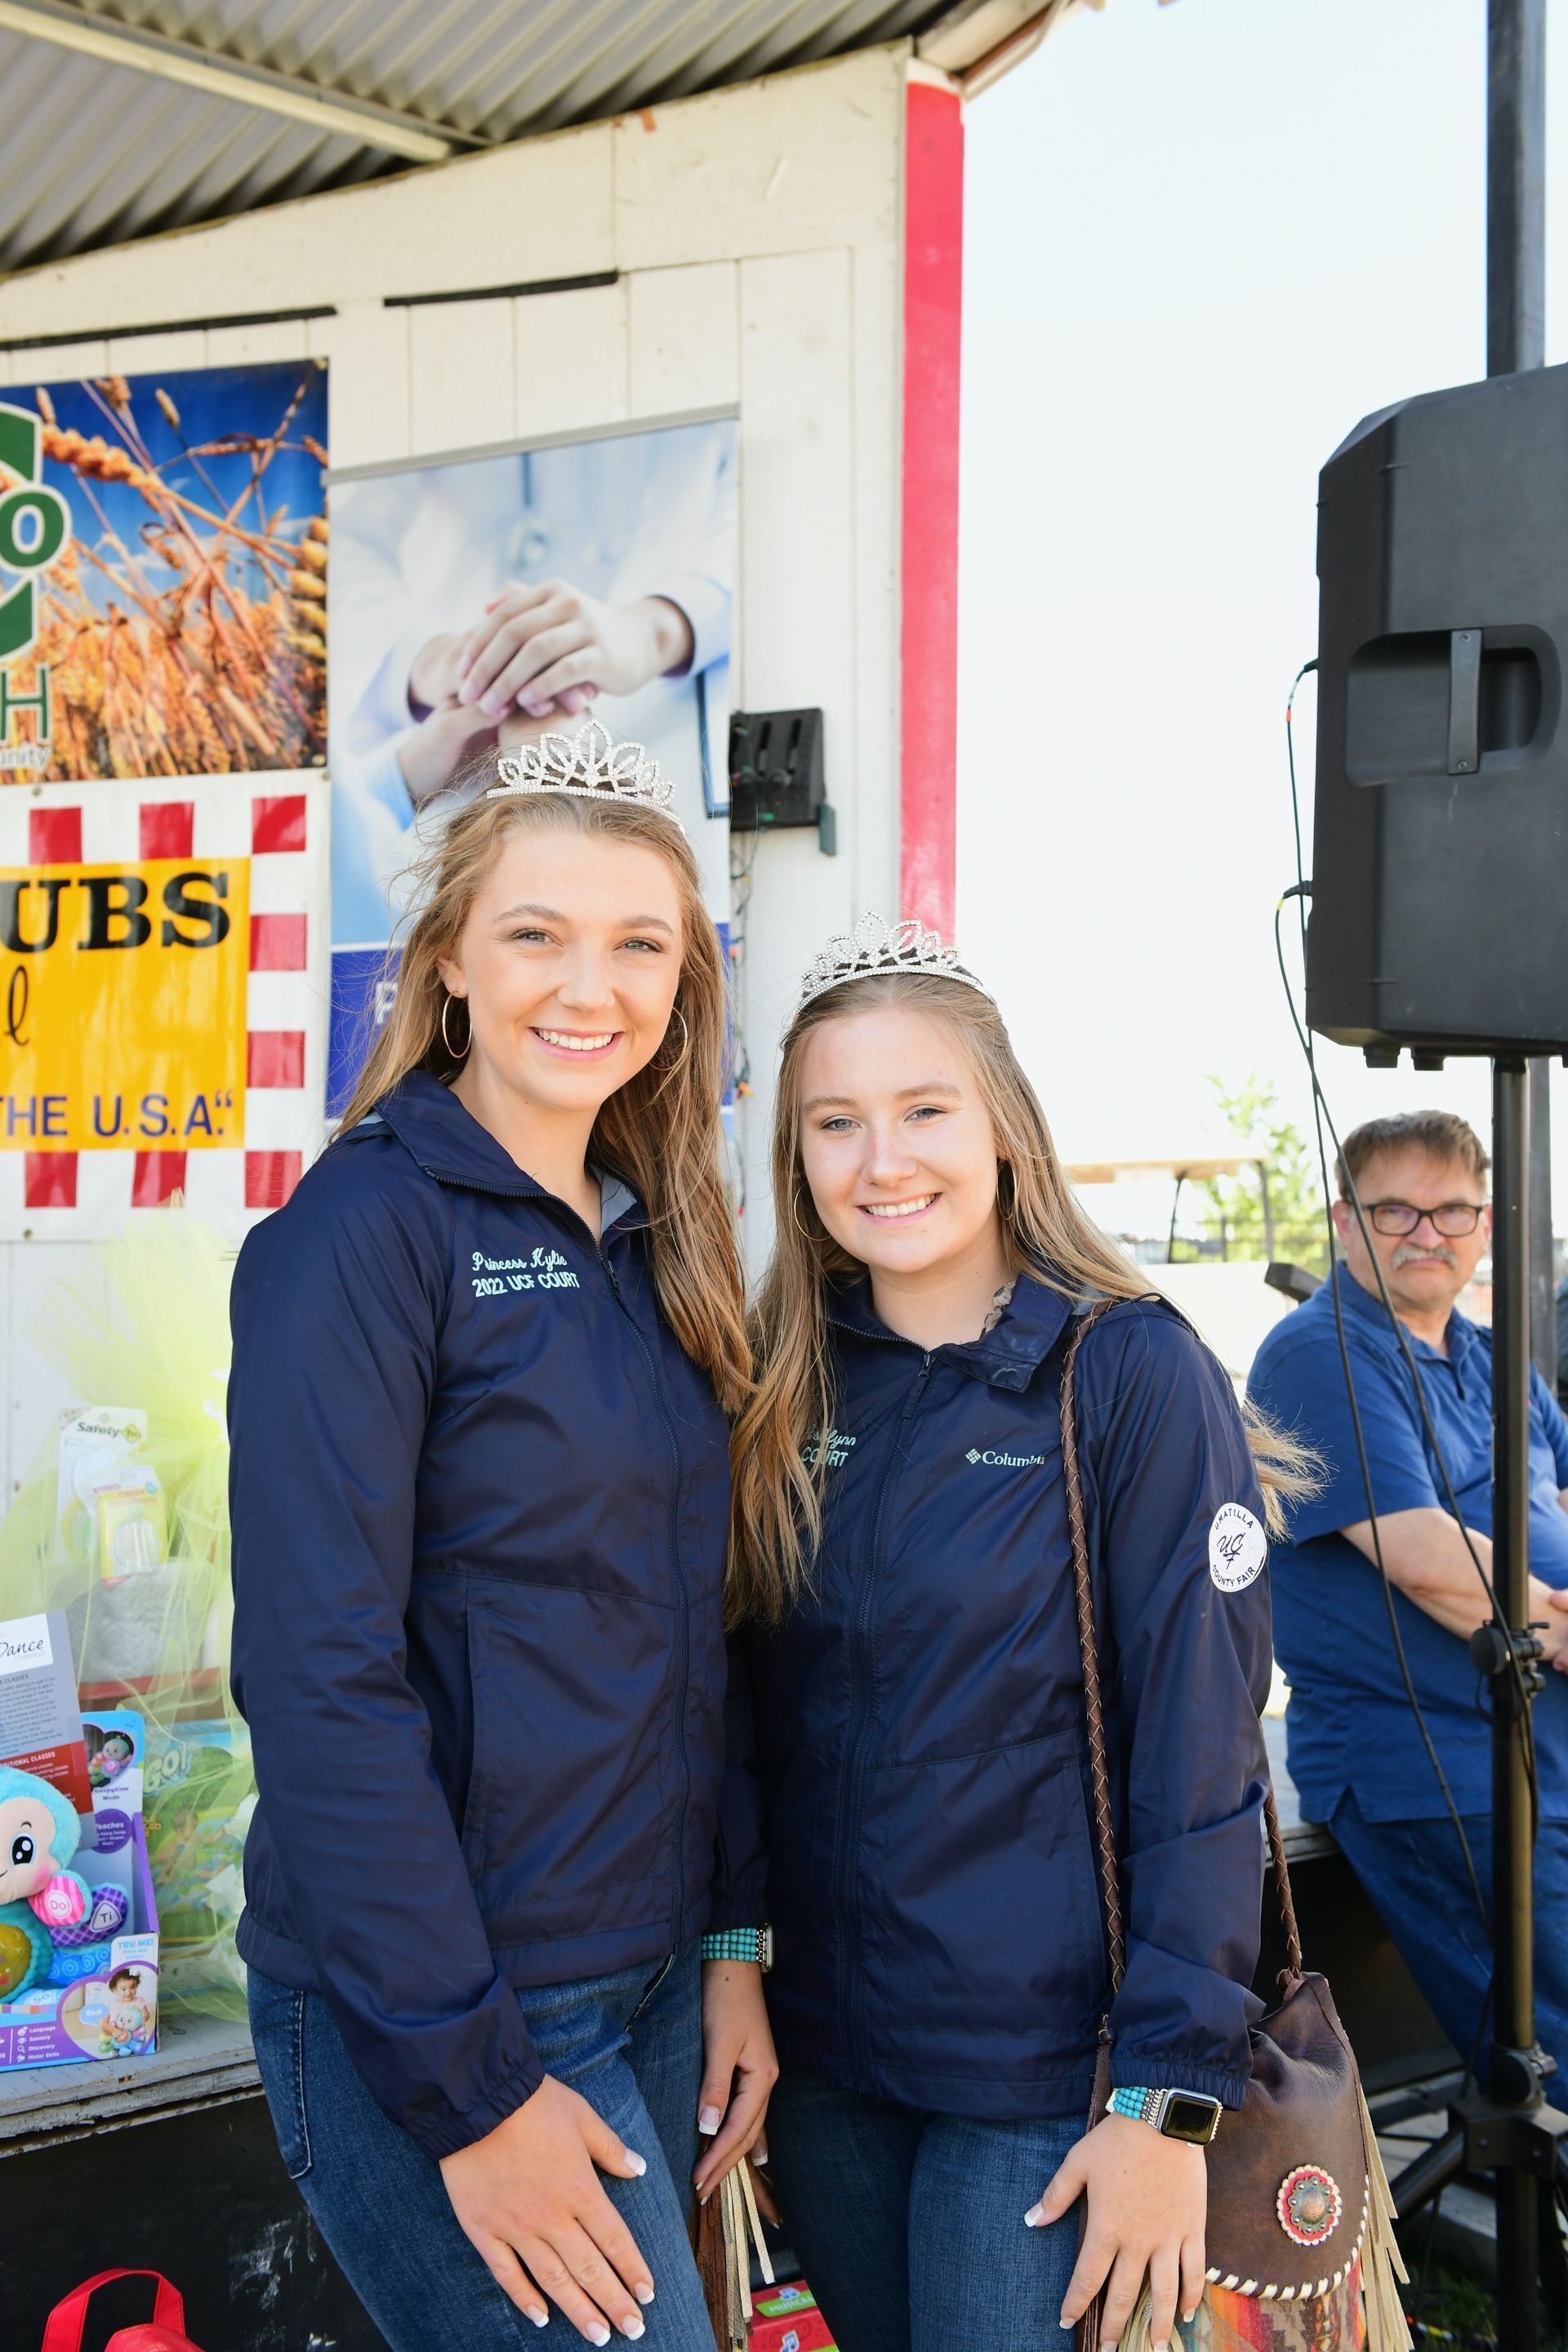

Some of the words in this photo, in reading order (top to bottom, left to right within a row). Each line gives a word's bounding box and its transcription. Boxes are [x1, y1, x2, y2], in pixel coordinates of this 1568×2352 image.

[0, 1095, 67, 1137] HE
[472, 1251, 528, 1272] Princess
[530, 1247, 568, 1272] Kylie
[472, 1277, 508, 1298] 2022
[506, 1274, 536, 1291] UCF
[537, 1271, 580, 1289] COURT
[77, 1421, 120, 1439] Safety
[982, 1450, 1045, 1467] Columbia
[1214, 1508, 1254, 1530] UMATILLA
[1212, 1564, 1235, 1588] COUNTY
[1236, 1566, 1256, 1585] FAIR
[4, 1674, 29, 1684] CLASSES
[30, 1751, 56, 1762] CLASSES
[50, 1900, 66, 1910] Do
[100, 1911, 113, 1922] Ti
[118, 1940, 136, 1949] TRY
[138, 1938, 154, 1947] ME!
[33, 1993, 49, 2003] So
